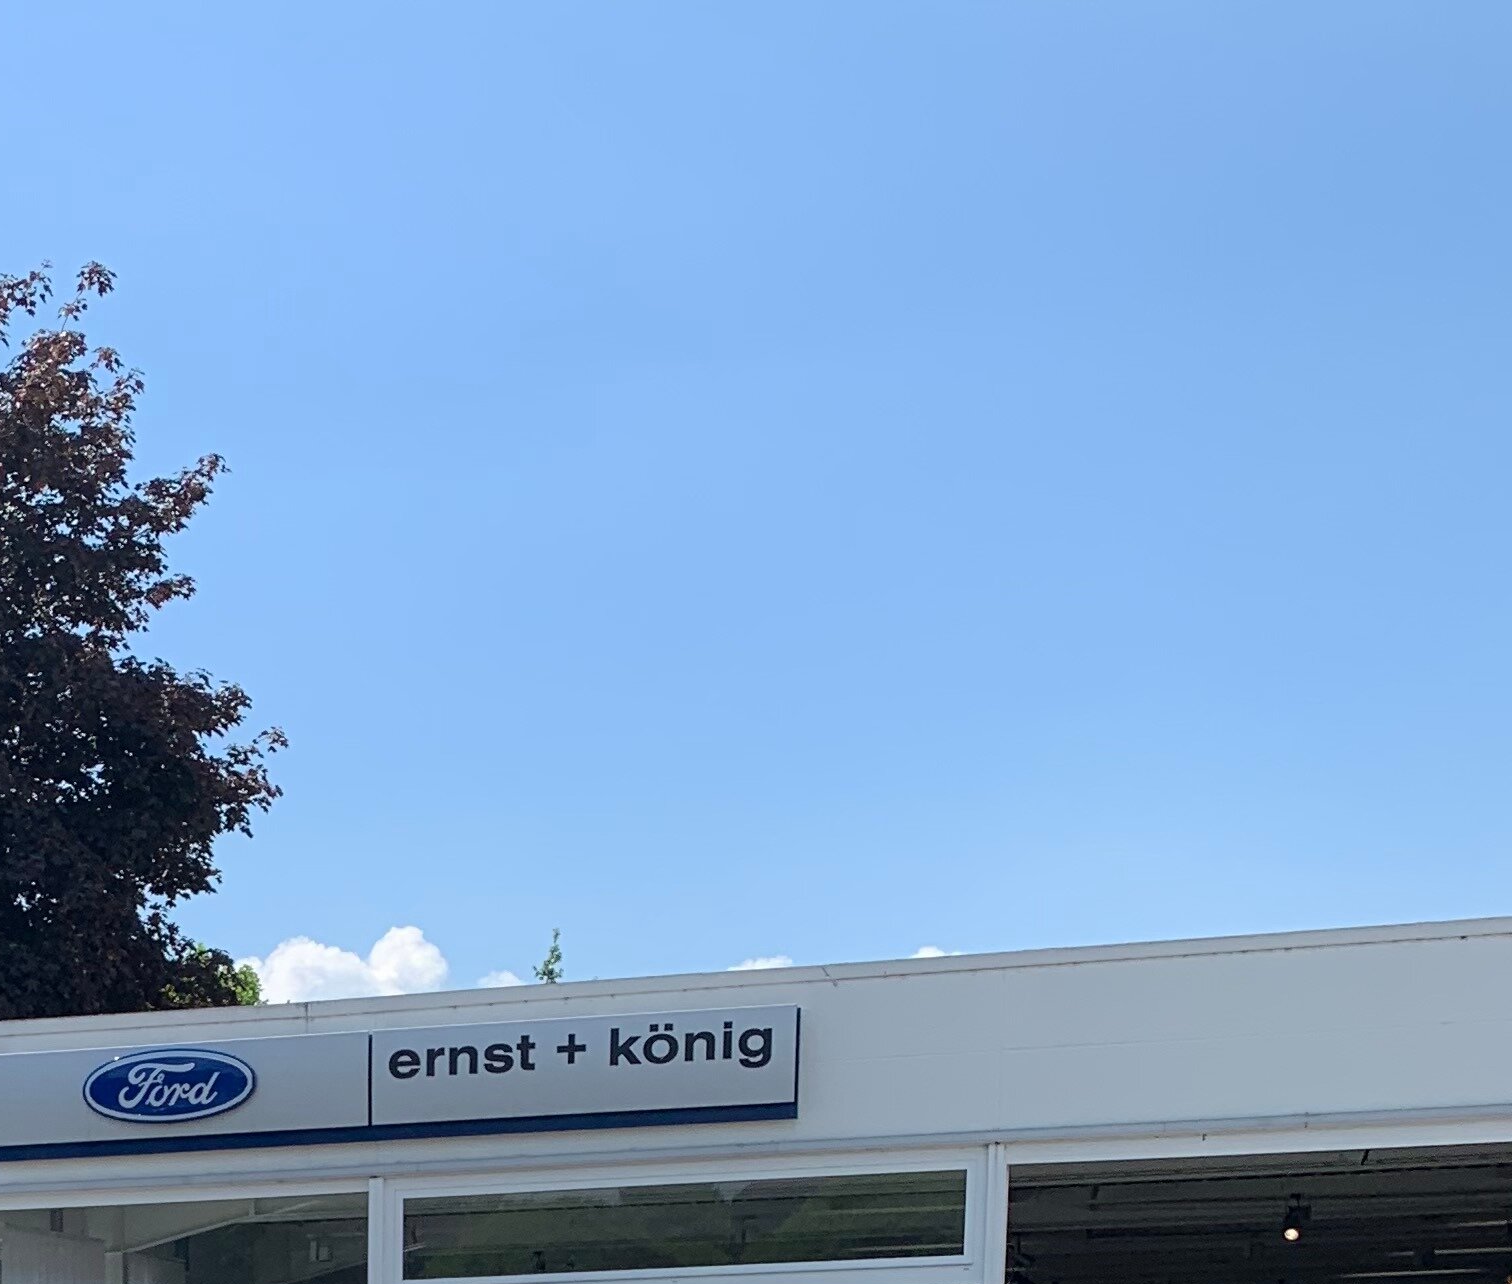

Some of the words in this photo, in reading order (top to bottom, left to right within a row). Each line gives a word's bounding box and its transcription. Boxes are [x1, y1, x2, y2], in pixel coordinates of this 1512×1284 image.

[388, 1034, 537, 1079] ernst
[557, 1034, 586, 1063] +
[609, 1020, 774, 1068] könig
[118, 1062, 221, 1110] Ford
